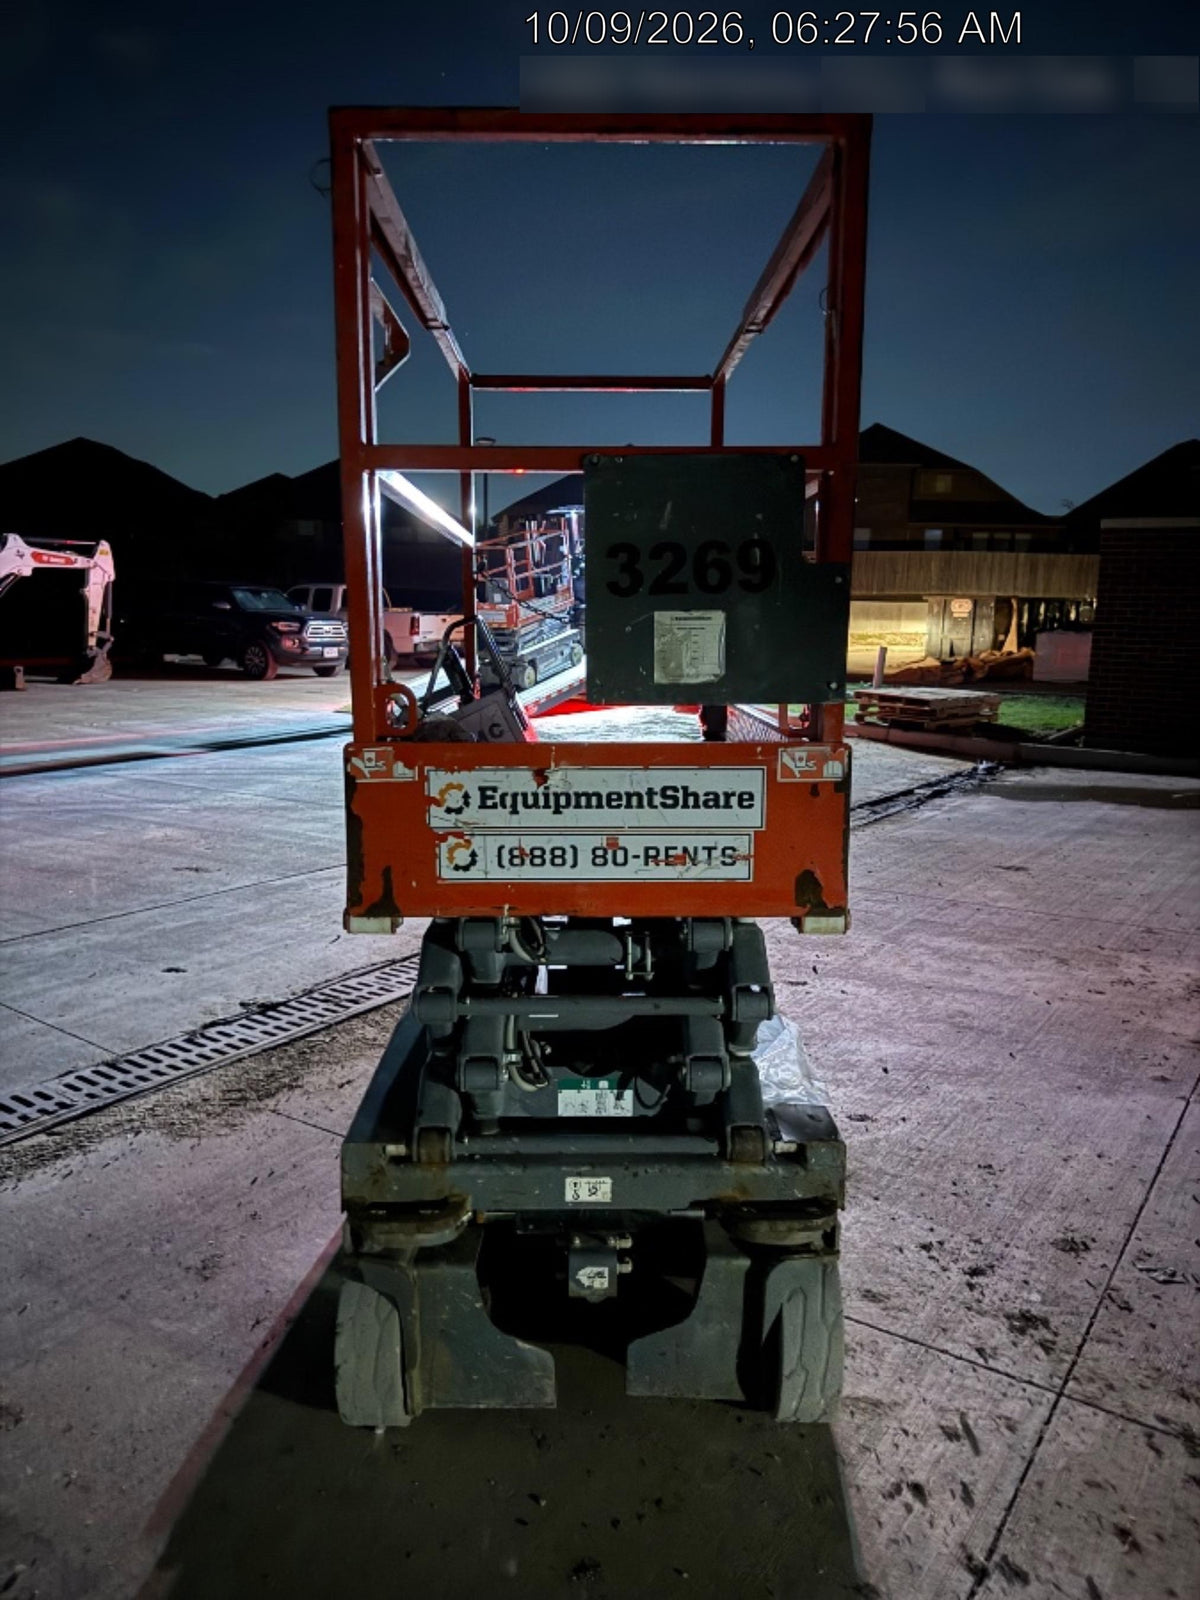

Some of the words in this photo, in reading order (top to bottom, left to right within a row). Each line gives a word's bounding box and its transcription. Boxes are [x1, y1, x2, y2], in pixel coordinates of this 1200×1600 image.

[605, 539, 777, 598] 3269
[477, 785, 756, 815] EquipmentShare
[496, 844, 579, 869] (888)
[591, 845, 738, 867] 80-RENTS
